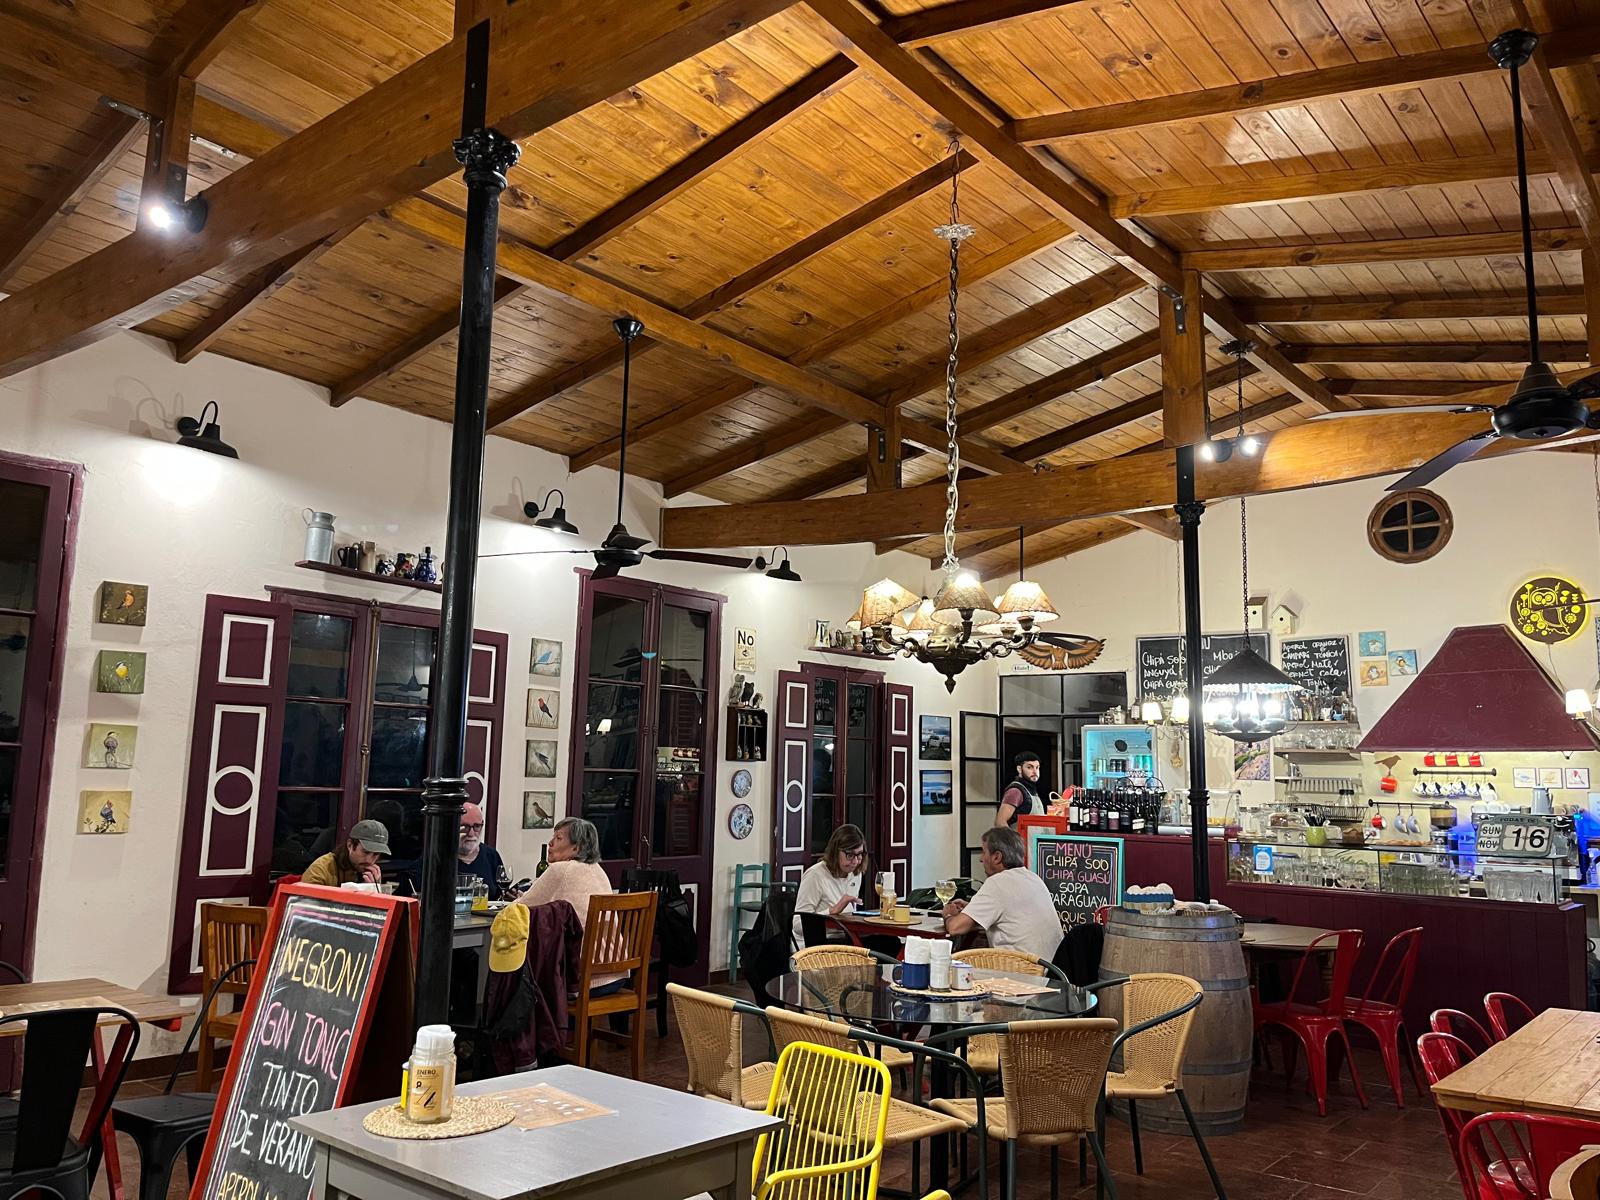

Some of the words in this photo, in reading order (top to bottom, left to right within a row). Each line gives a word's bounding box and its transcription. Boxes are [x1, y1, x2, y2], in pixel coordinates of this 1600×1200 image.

[737, 630, 754, 646] No
[1482, 826, 1501, 835] SUN
[1512, 828, 1546, 849] 16
[1055, 842, 1092, 859] MENÚ
[1479, 839, 1498, 849] NOV
[1045, 855, 1078, 868] CHIPÁ
[1059, 882, 1089, 894] SOPA
[279, 937, 368, 1002] NEGRONI
[260, 1001, 298, 1051] GIN
[298, 1012, 351, 1080] TONIC
[260, 1061, 319, 1116] TINTO
[230, 1109, 259, 1156] DE
